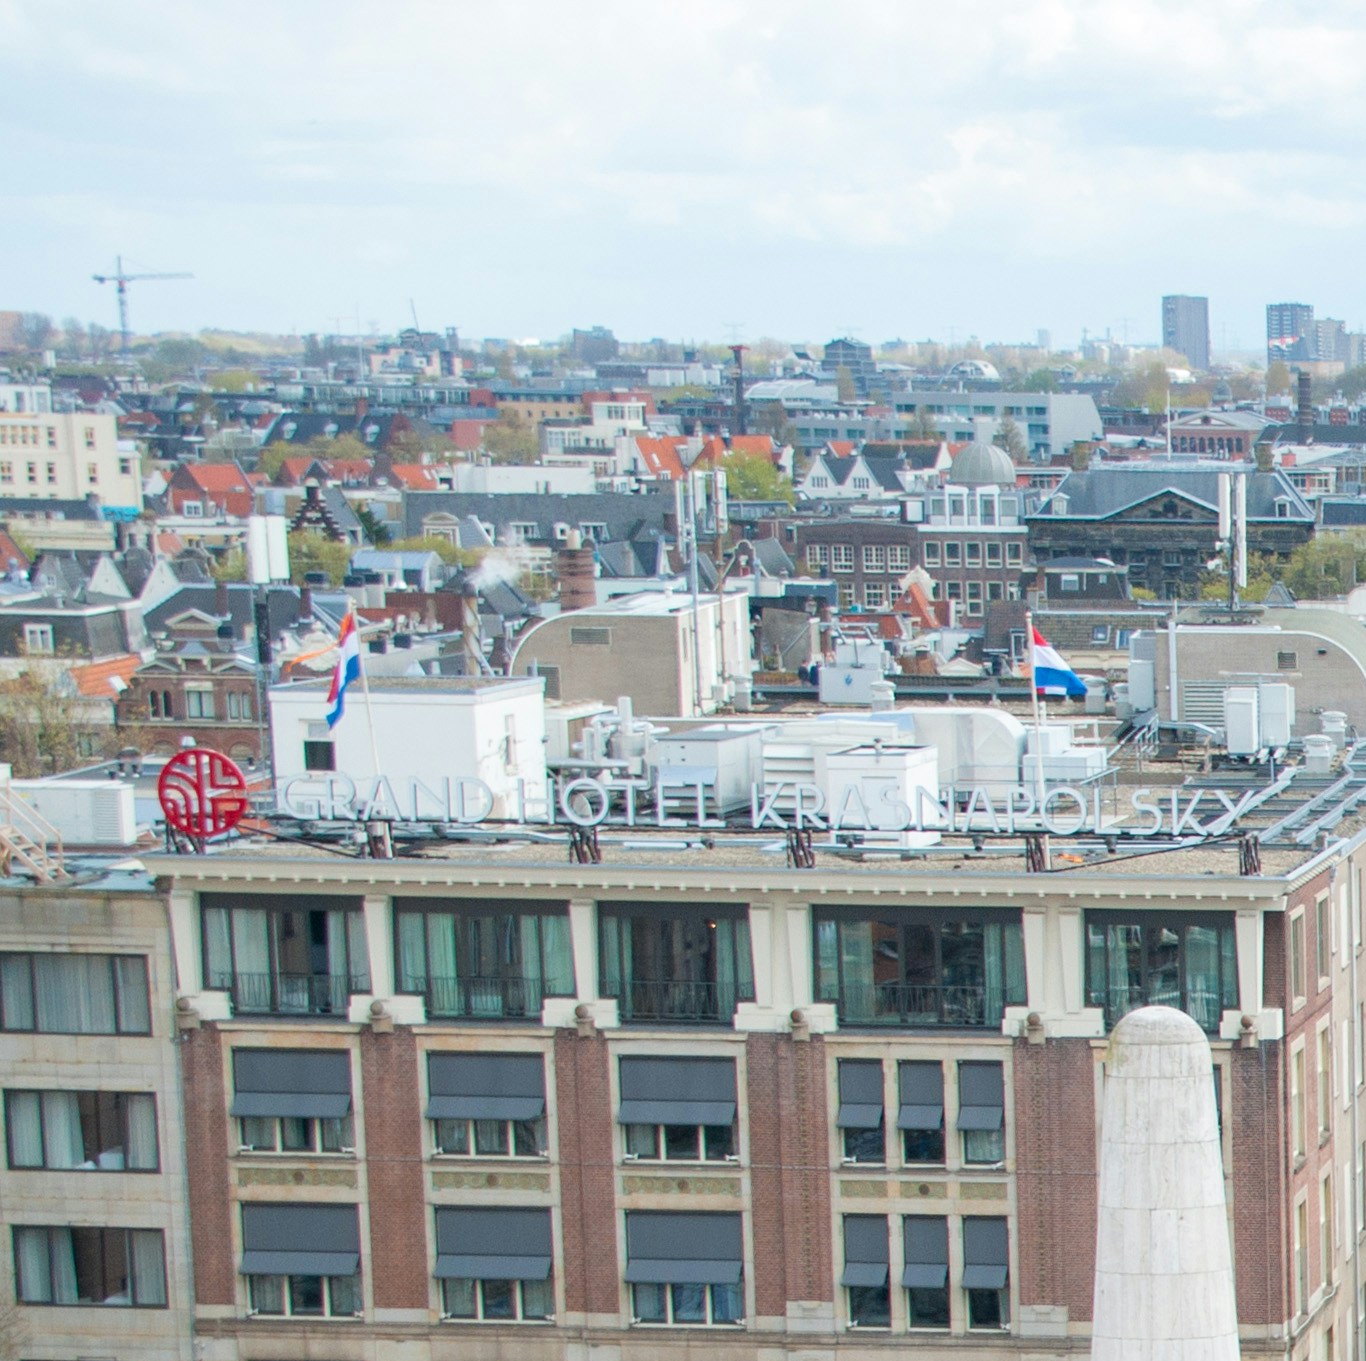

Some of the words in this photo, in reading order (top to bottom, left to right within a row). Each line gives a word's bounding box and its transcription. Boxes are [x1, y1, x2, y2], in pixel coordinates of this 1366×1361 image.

[279, 772, 494, 824] GRAND
[517, 777, 726, 828] HOTEL
[752, 781, 1256, 837] KRASNAPOLSKY
